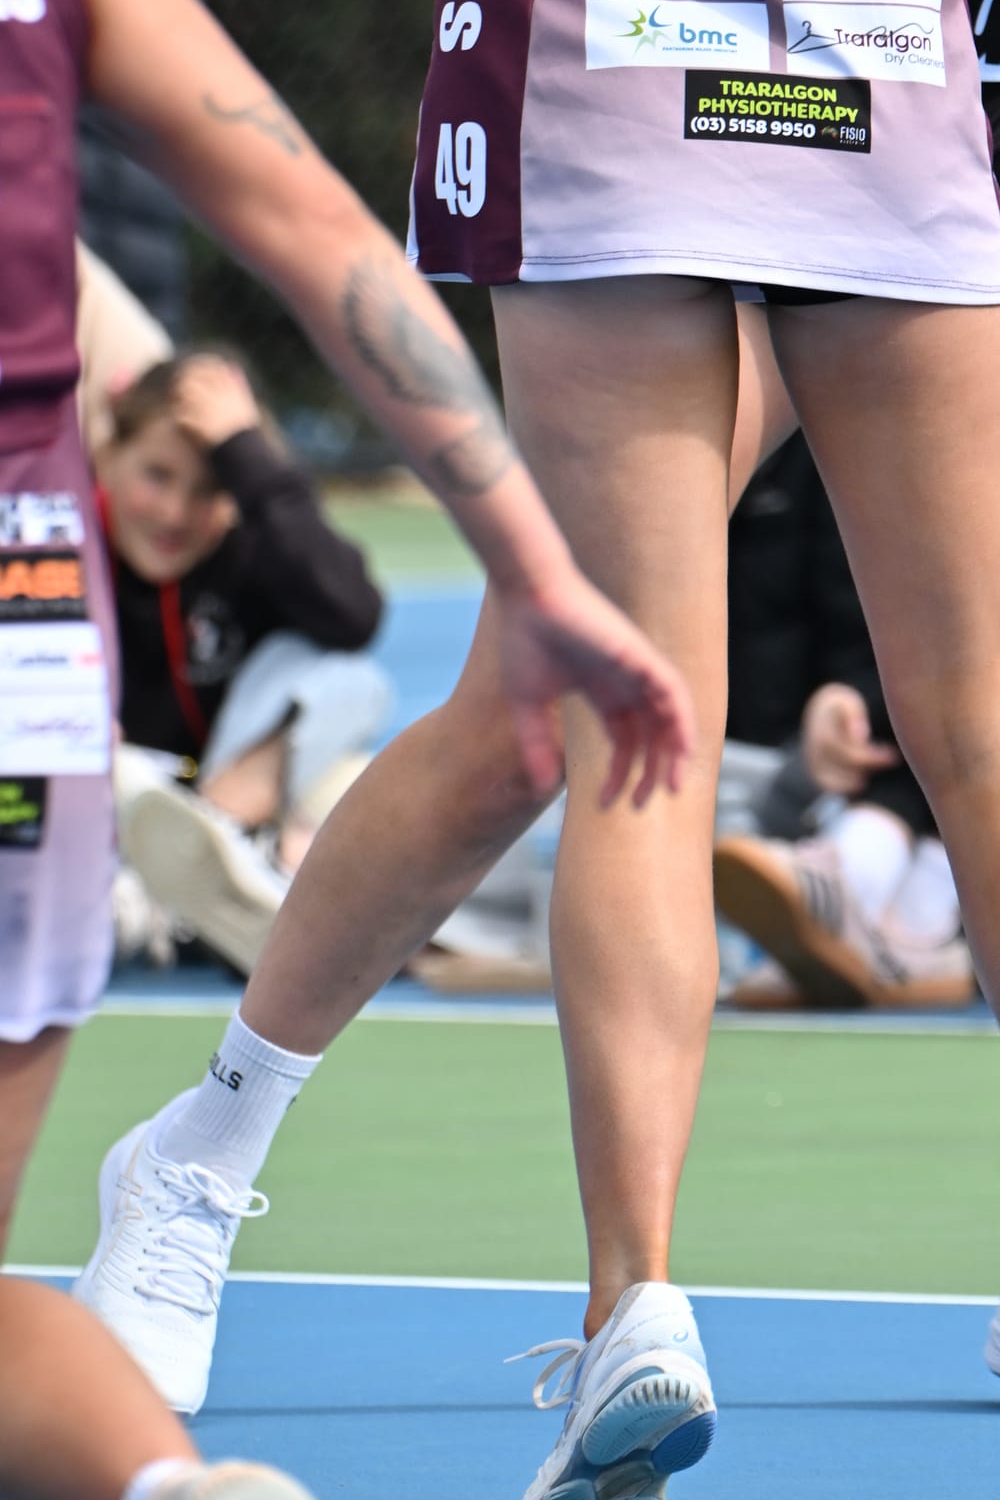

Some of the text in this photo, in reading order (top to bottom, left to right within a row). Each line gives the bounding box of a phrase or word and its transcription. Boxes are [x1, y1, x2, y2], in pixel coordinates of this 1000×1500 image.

[679, 22, 738, 46] bmc
[834, 26, 932, 53] Traralgon
[885, 52, 905, 66] Dry
[719, 80, 837, 102] TRARALGON
[698, 98, 859, 124] PHYSIOTHERAPY
[690, 116, 816, 139] (03) 5158 9950
[840, 126, 866, 142] FISIO
[435, 121, 487, 218] 49
